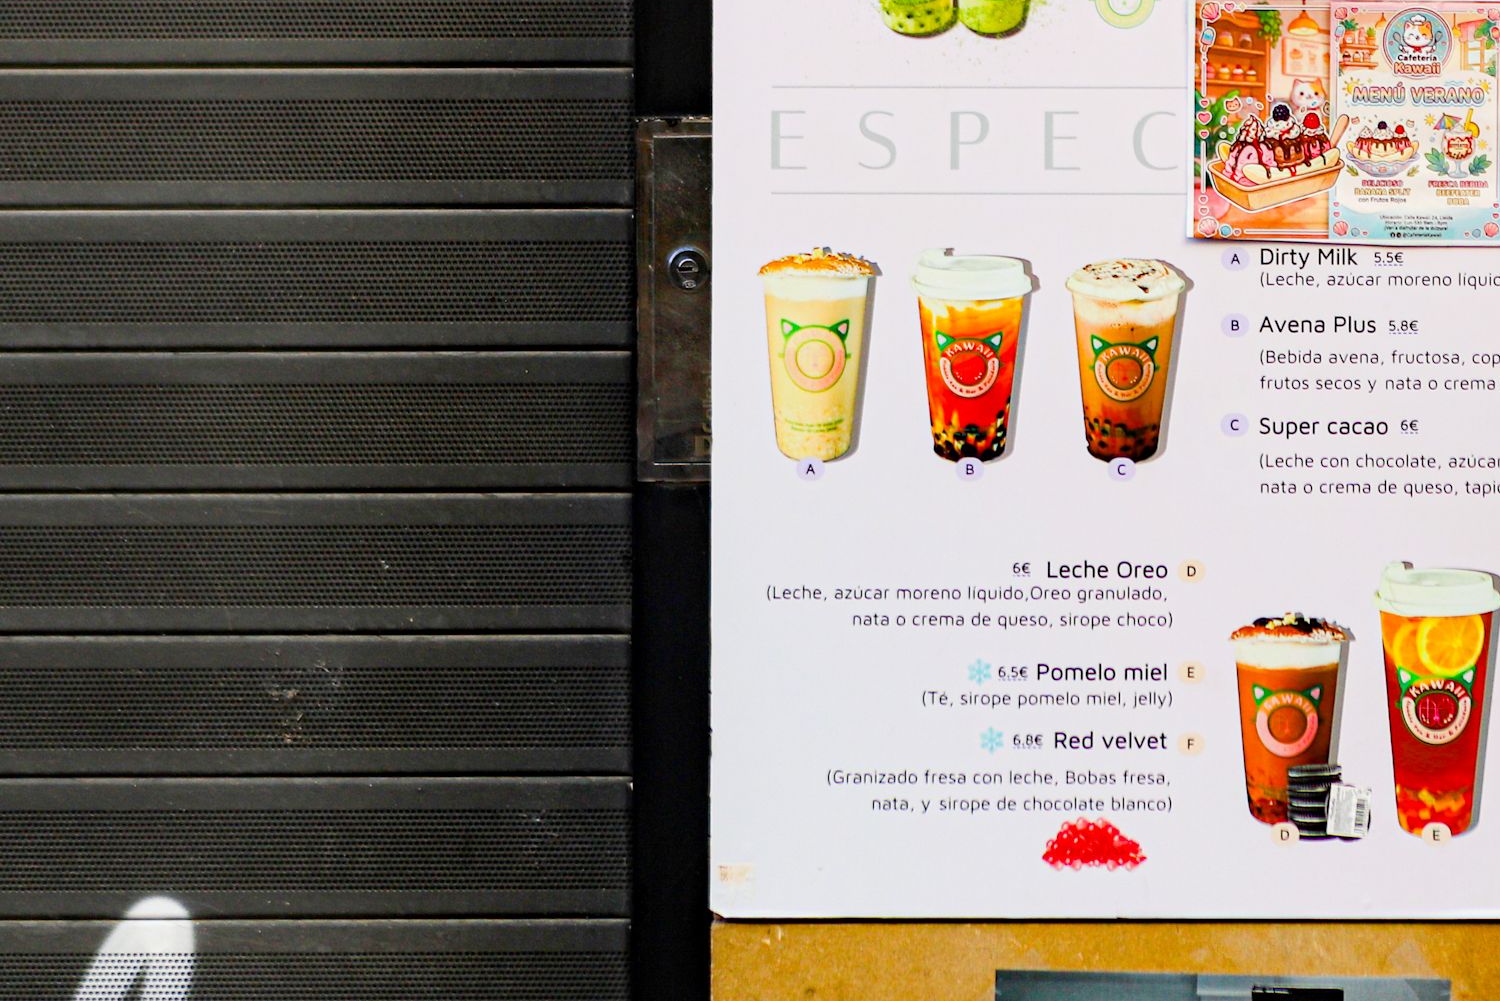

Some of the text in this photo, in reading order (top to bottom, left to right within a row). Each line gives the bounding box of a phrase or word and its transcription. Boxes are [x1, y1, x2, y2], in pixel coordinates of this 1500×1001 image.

[1393, 61, 1441, 75] Kawaii
[1352, 81, 1486, 105] MENÚ VERANO
[1230, 247, 1404, 269] A Dirty Milk 5.5€
[1260, 271, 1320, 288] (Leche,
[1326, 272, 1382, 287] azúcar
[1388, 275, 1452, 287] moreno
[1230, 315, 1419, 334] B Avena Plus 5.8€
[1230, 417, 1419, 440] C Super cacao 6€
[805, 463, 816, 475] A
[965, 463, 975, 476] B
[1117, 463, 1126, 476] C
[1012, 559, 1197, 579] 6€ Leche Oreo D
[998, 663, 1195, 682] 6.5€ Pomelo miel E
[922, 690, 1173, 709] (Té, sirope pomelo miel, jelly)
[1013, 730, 1195, 750] 6.8€ Red velvet F
[1280, 828, 1290, 841] D
[1432, 829, 1440, 842] E
